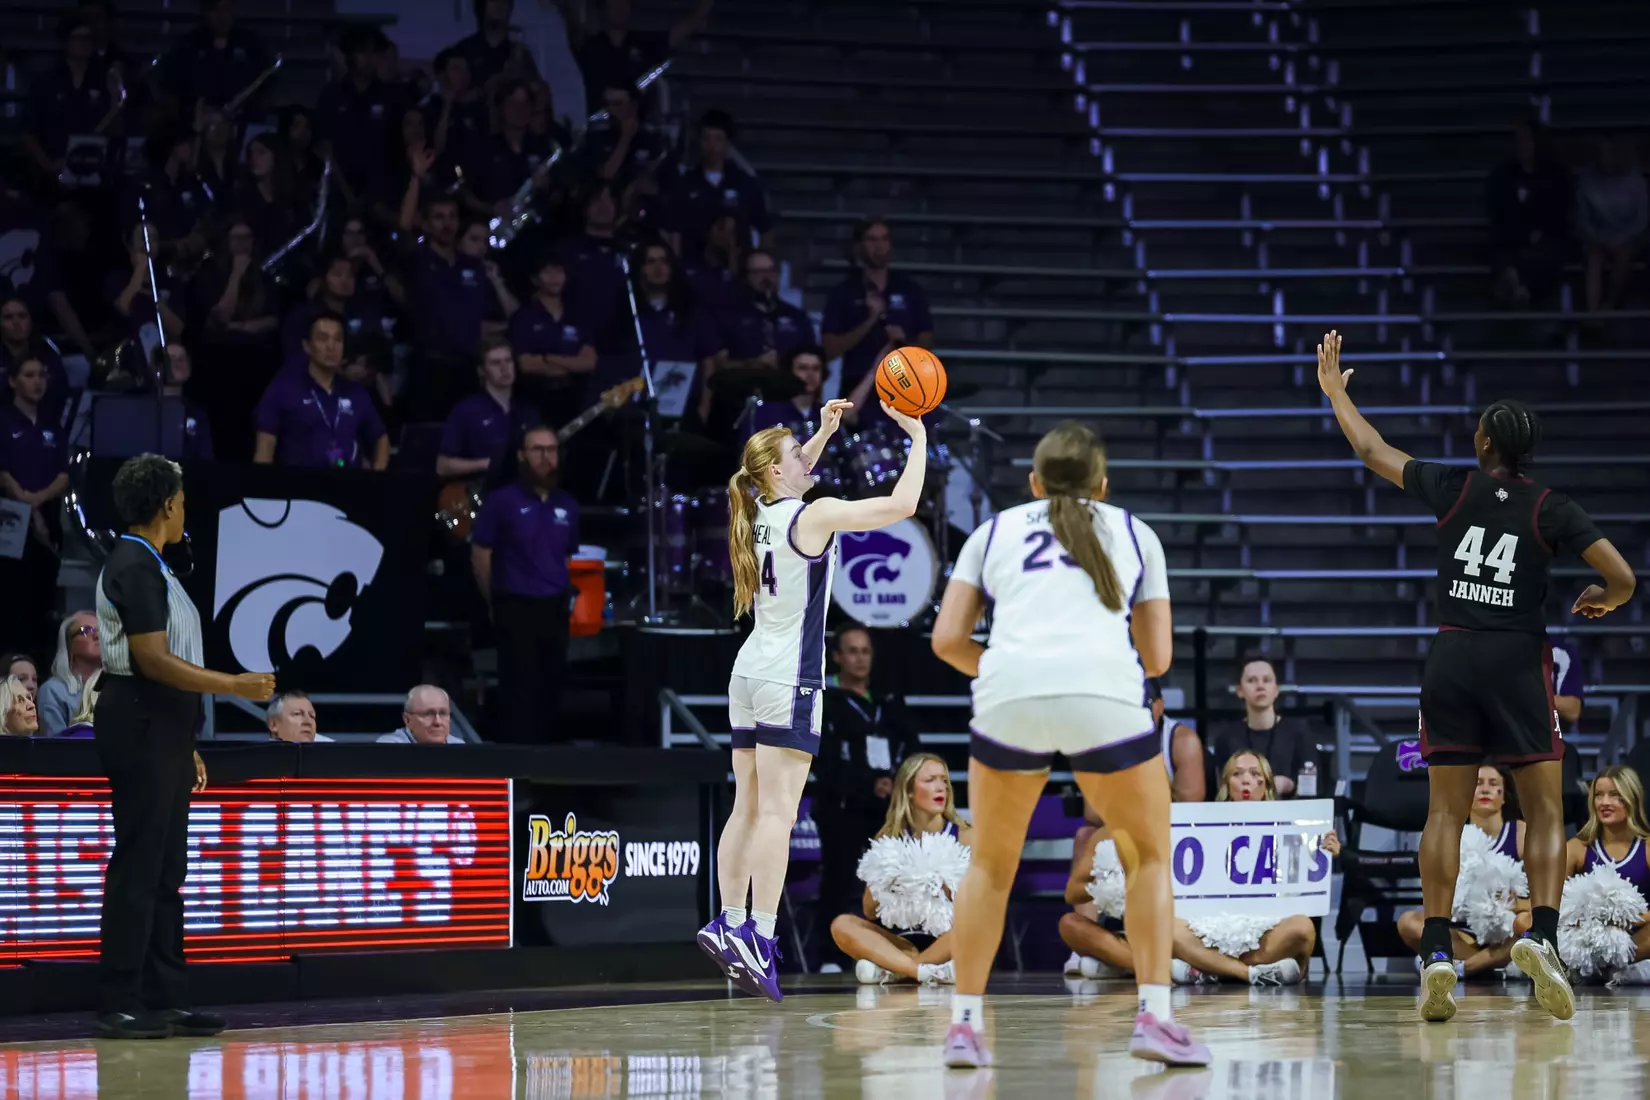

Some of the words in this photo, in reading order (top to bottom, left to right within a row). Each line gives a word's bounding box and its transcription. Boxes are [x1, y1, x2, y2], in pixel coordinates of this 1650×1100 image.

[752, 523, 771, 545] HEAL
[1022, 530, 1081, 571] 2
[1454, 525, 1519, 584] 44
[761, 550, 777, 596] 4
[1449, 579, 1515, 607] JANNEH
[852, 592, 871, 604] CAT
[877, 592, 906, 604] BAND
[526, 813, 619, 899] Briggs
[625, 841, 666, 876] SINCE
[666, 841, 700, 876] 1979
[1225, 834, 1329, 885] CATS
[526, 880, 569, 896] AUTO.COM
